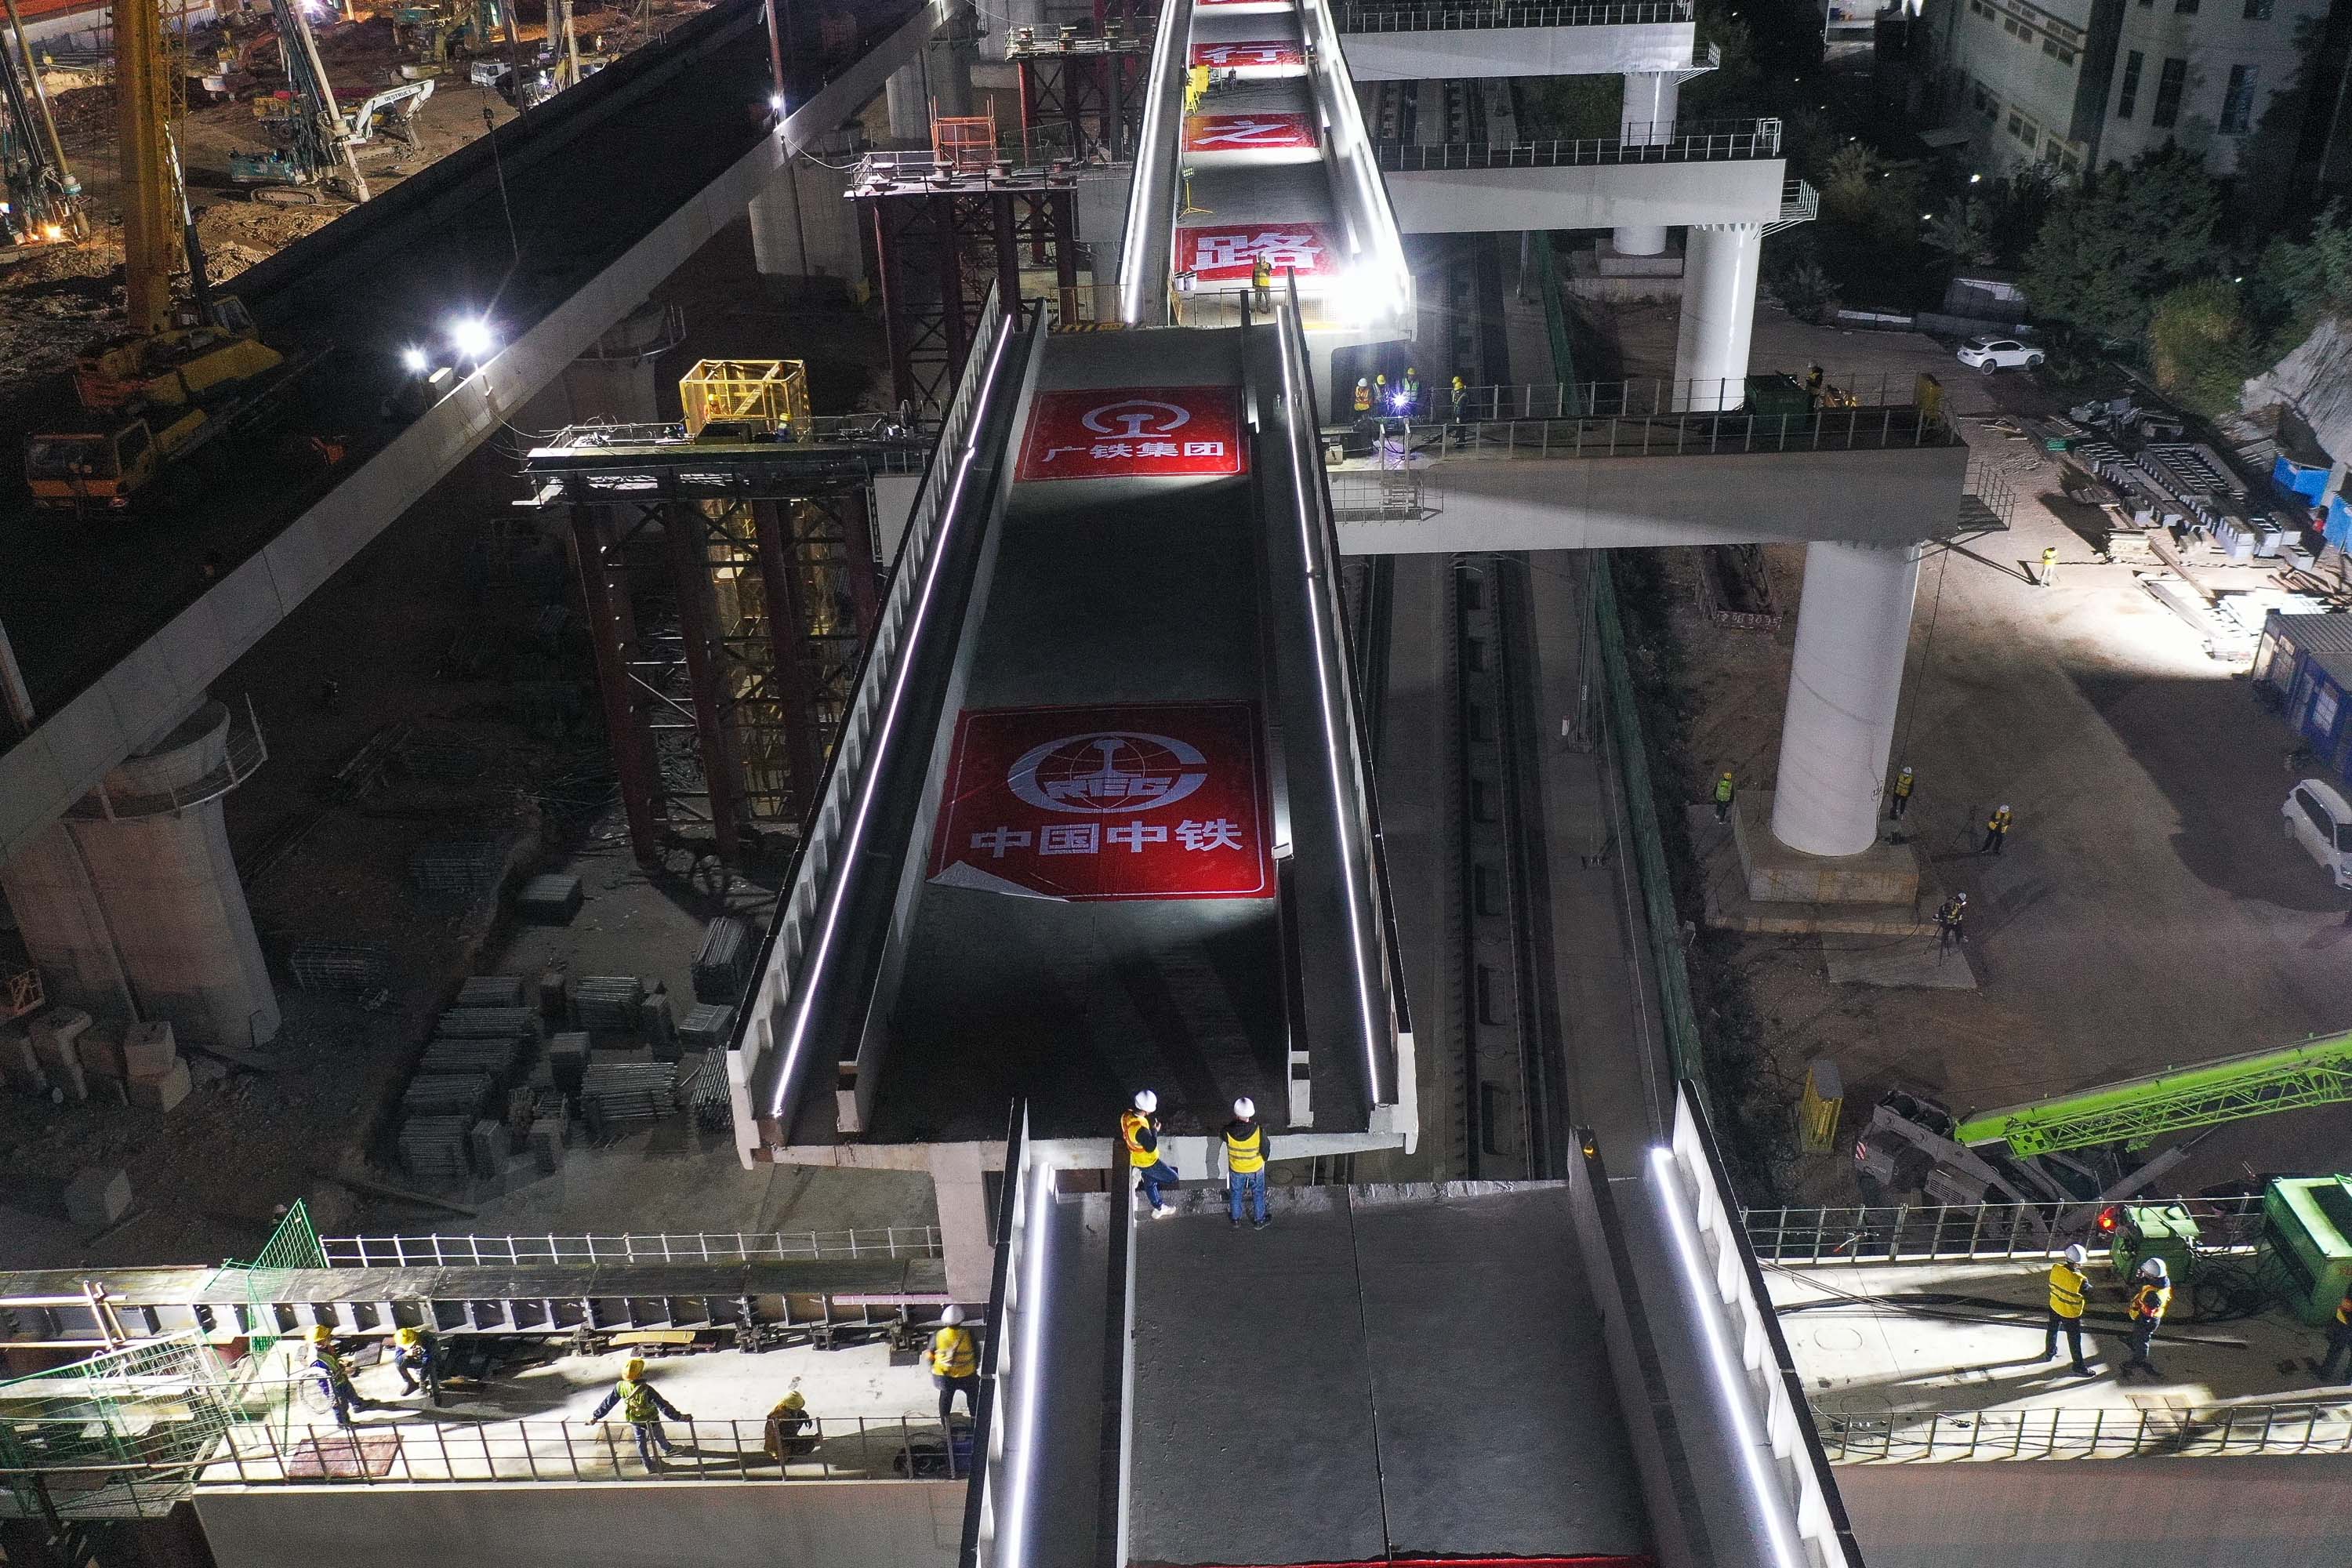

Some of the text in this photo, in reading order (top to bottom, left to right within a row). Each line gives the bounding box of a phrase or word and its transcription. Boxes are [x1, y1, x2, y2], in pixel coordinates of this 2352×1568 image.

[1200, 45, 1290, 64] 行
[1193, 121, 1301, 144] 之
[1190, 232, 1324, 270] 路
[1041, 441, 1225, 462] 广铁集团
[970, 818, 1243, 858] 中国中铁
